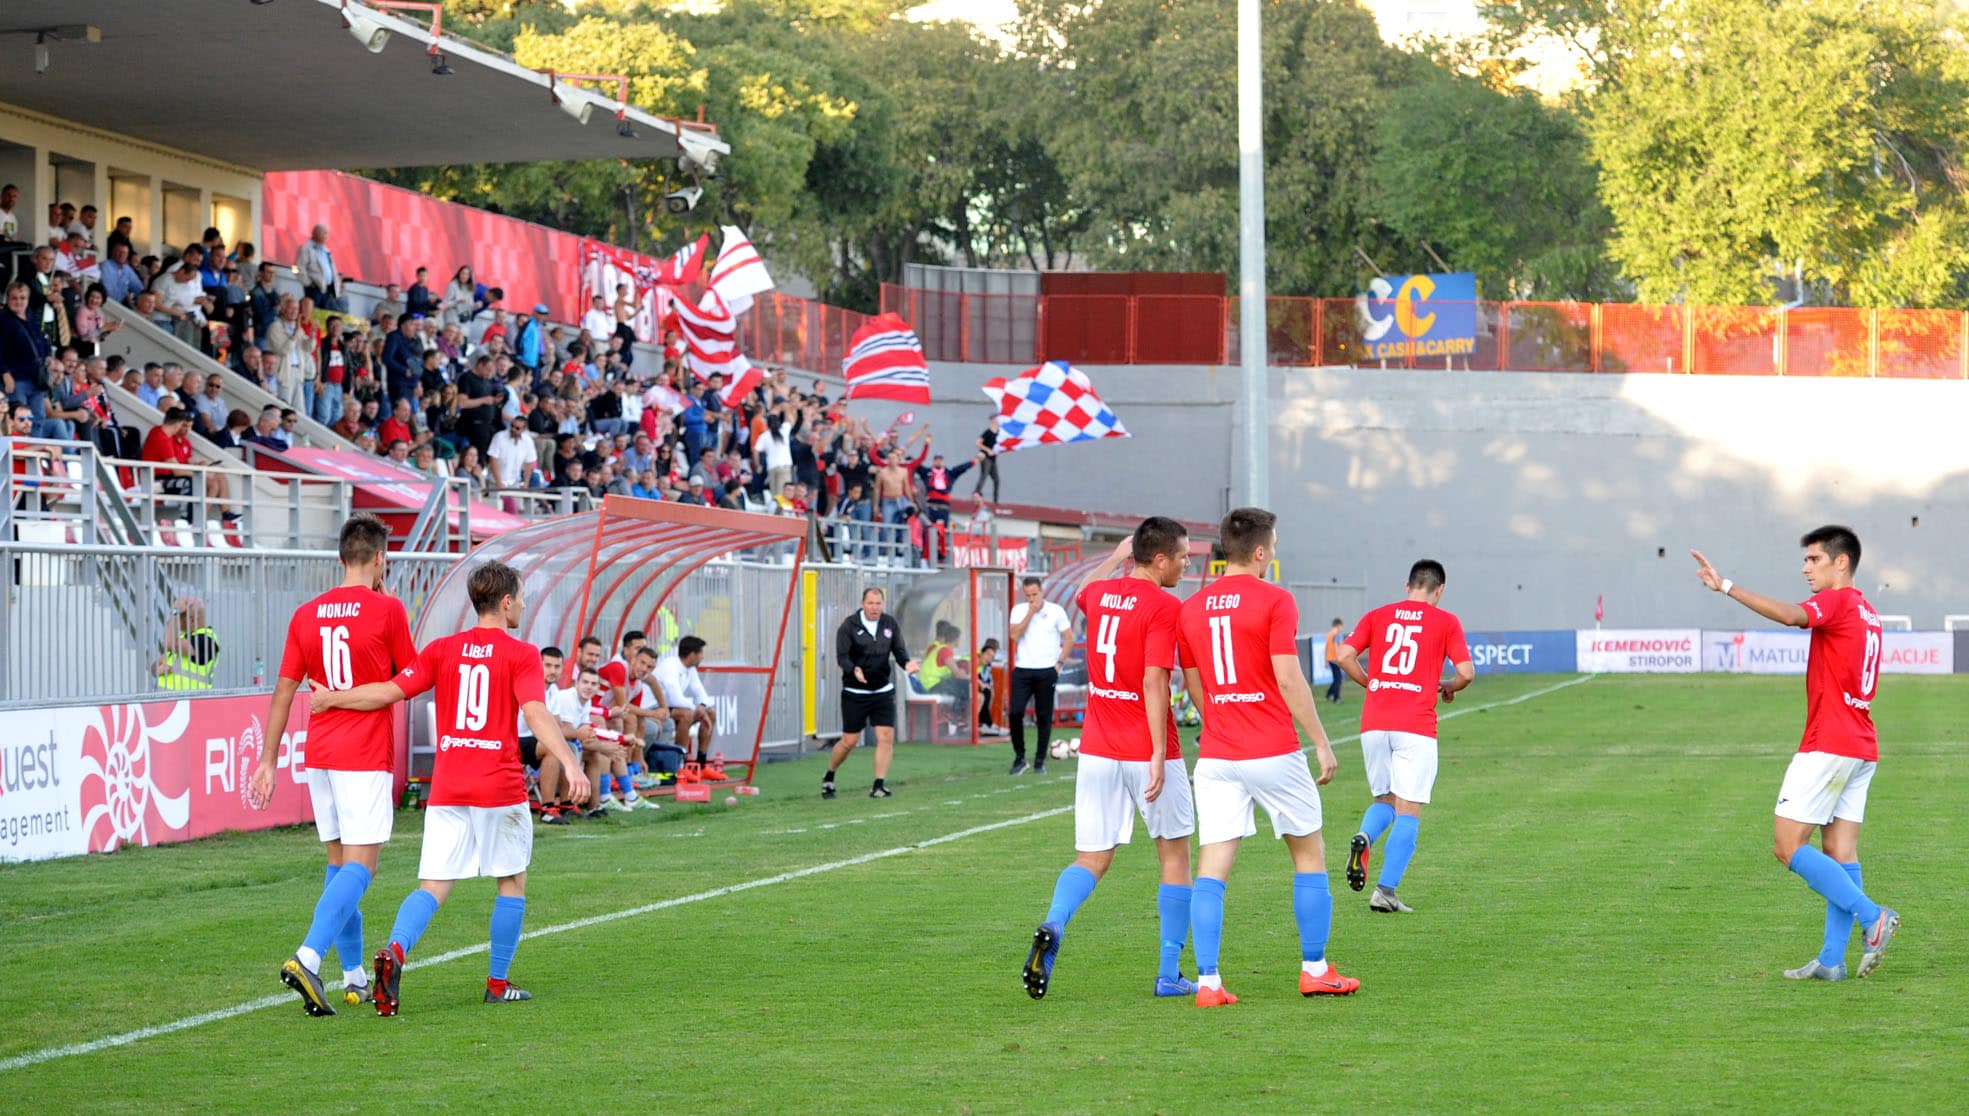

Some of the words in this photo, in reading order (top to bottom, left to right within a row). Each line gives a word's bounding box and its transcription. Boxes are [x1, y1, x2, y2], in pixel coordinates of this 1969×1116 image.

[317, 602, 361, 619] MONJAC
[1100, 592, 1138, 611] MULAC
[1206, 594, 1241, 610] FLEGO
[1395, 608, 1424, 621] VIDAS
[461, 643, 494, 659] LIBER
[1096, 614, 1120, 683] 4
[1209, 615, 1238, 686] 11
[1381, 623, 1423, 676] 25
[1591, 636, 1691, 653] KEMENOVIĆ
[319, 625, 353, 691] 16
[1629, 656, 1692, 668] STIROPOR
[455, 664, 490, 731] 19
[0, 729, 60, 798] uest
